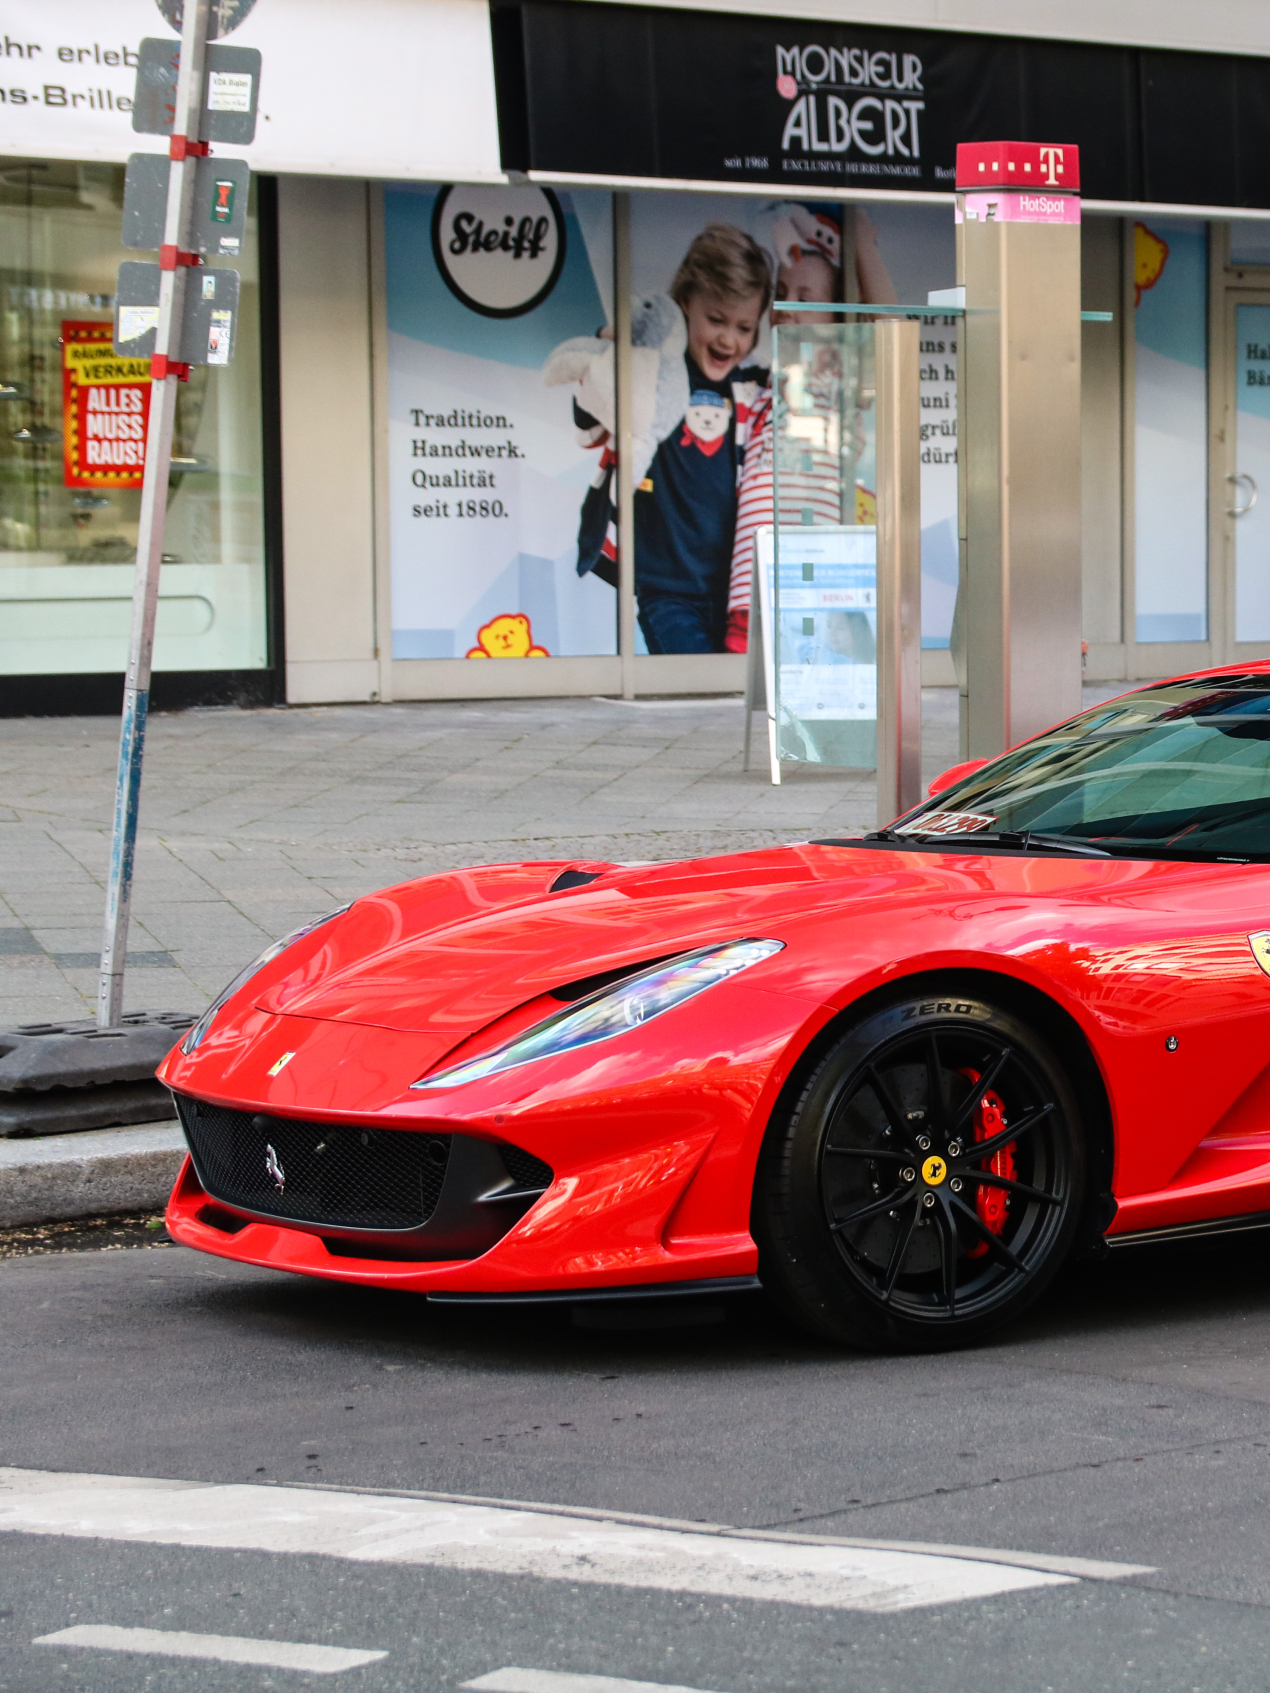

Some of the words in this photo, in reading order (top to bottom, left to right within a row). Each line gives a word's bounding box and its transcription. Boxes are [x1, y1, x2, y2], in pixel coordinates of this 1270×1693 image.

[0, 35, 42, 58] hr
[775, 44, 925, 91] MONSIEUR
[0, 84, 133, 112] s-Brille
[781, 95, 926, 158] ALBERT
[745, 156, 769, 169] 1968
[781, 158, 843, 173] EXCLUSIVE
[845, 161, 922, 177] HERRENMODE
[1040, 147, 1064, 185] T
[1019, 195, 1065, 215] HotSpot
[450, 211, 549, 260] Steiff
[87, 386, 144, 413] ALLES
[86, 413, 144, 440] MUSS
[410, 408, 514, 429] Tradition.
[87, 440, 145, 466] RAUS!
[411, 439, 526, 459] Handwerk.
[412, 468, 497, 490] Qualität
[412, 499, 450, 518] seit
[456, 499, 509, 518] 1880.
[822, 594, 854, 602] BERLIN
[901, 1002, 973, 1022] ZERO
